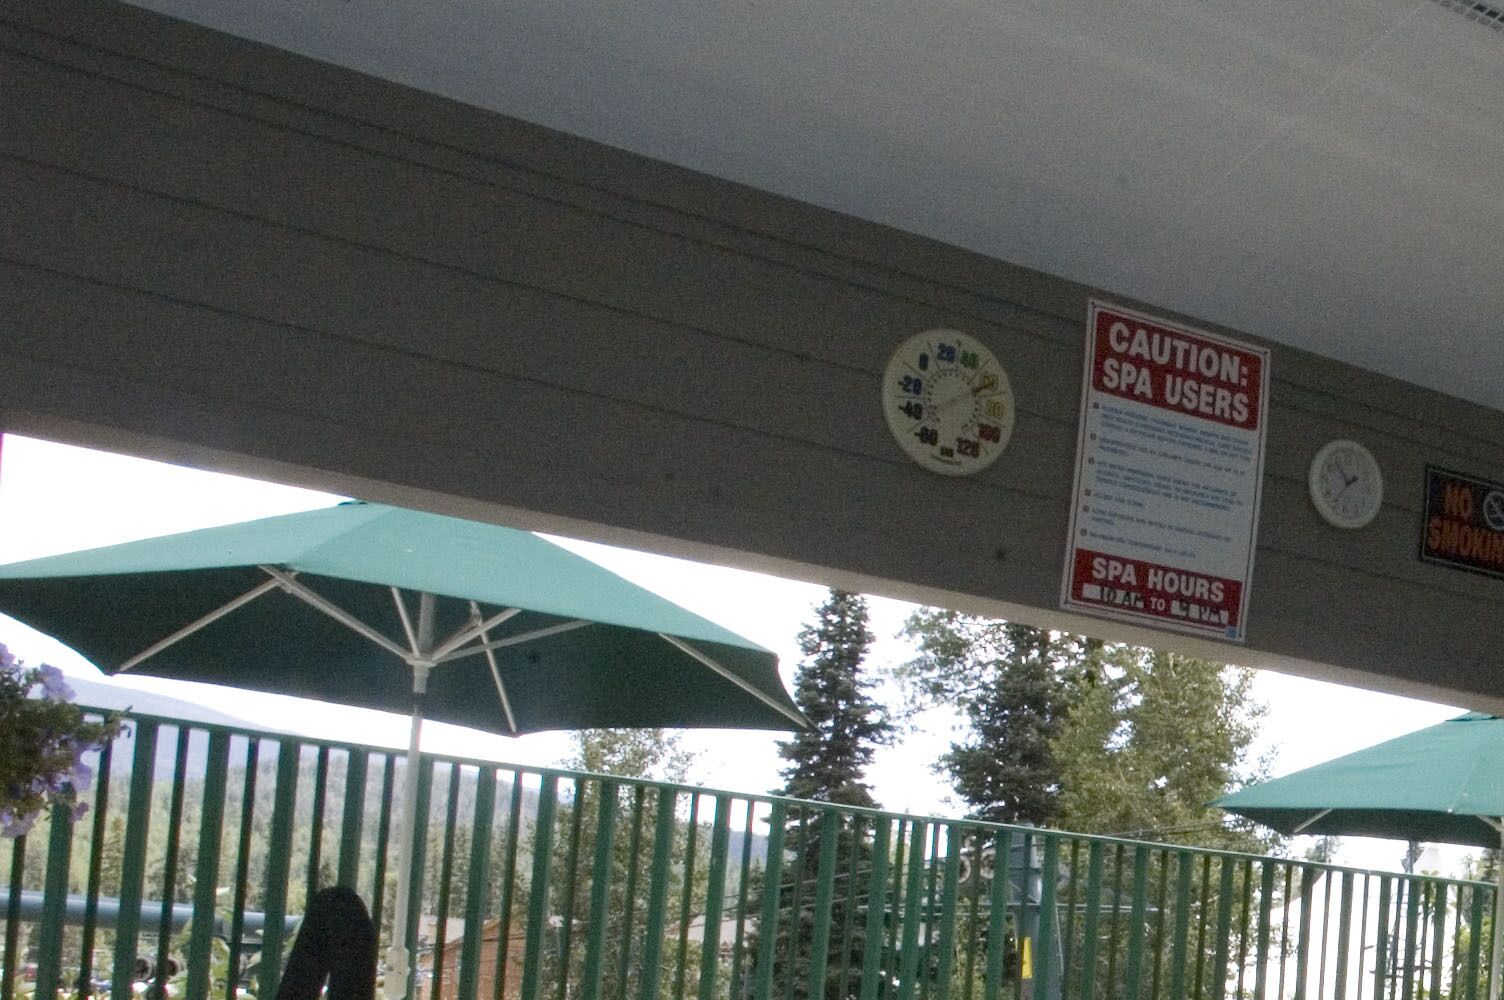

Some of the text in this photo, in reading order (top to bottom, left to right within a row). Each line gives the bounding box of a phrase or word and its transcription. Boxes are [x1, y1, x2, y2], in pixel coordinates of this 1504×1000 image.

[919, 353, 928, 371] 0
[937, 343, 956, 363] 20
[1109, 322, 1248, 387] CAUTION:
[898, 375, 922, 395] -20
[1103, 358, 1249, 423] SPA USERS
[898, 401, 923, 421] -40
[1445, 484, 1472, 518] NO
[1092, 557, 1225, 603] SPA HOURS
[1150, 597, 1166, 611] TO
